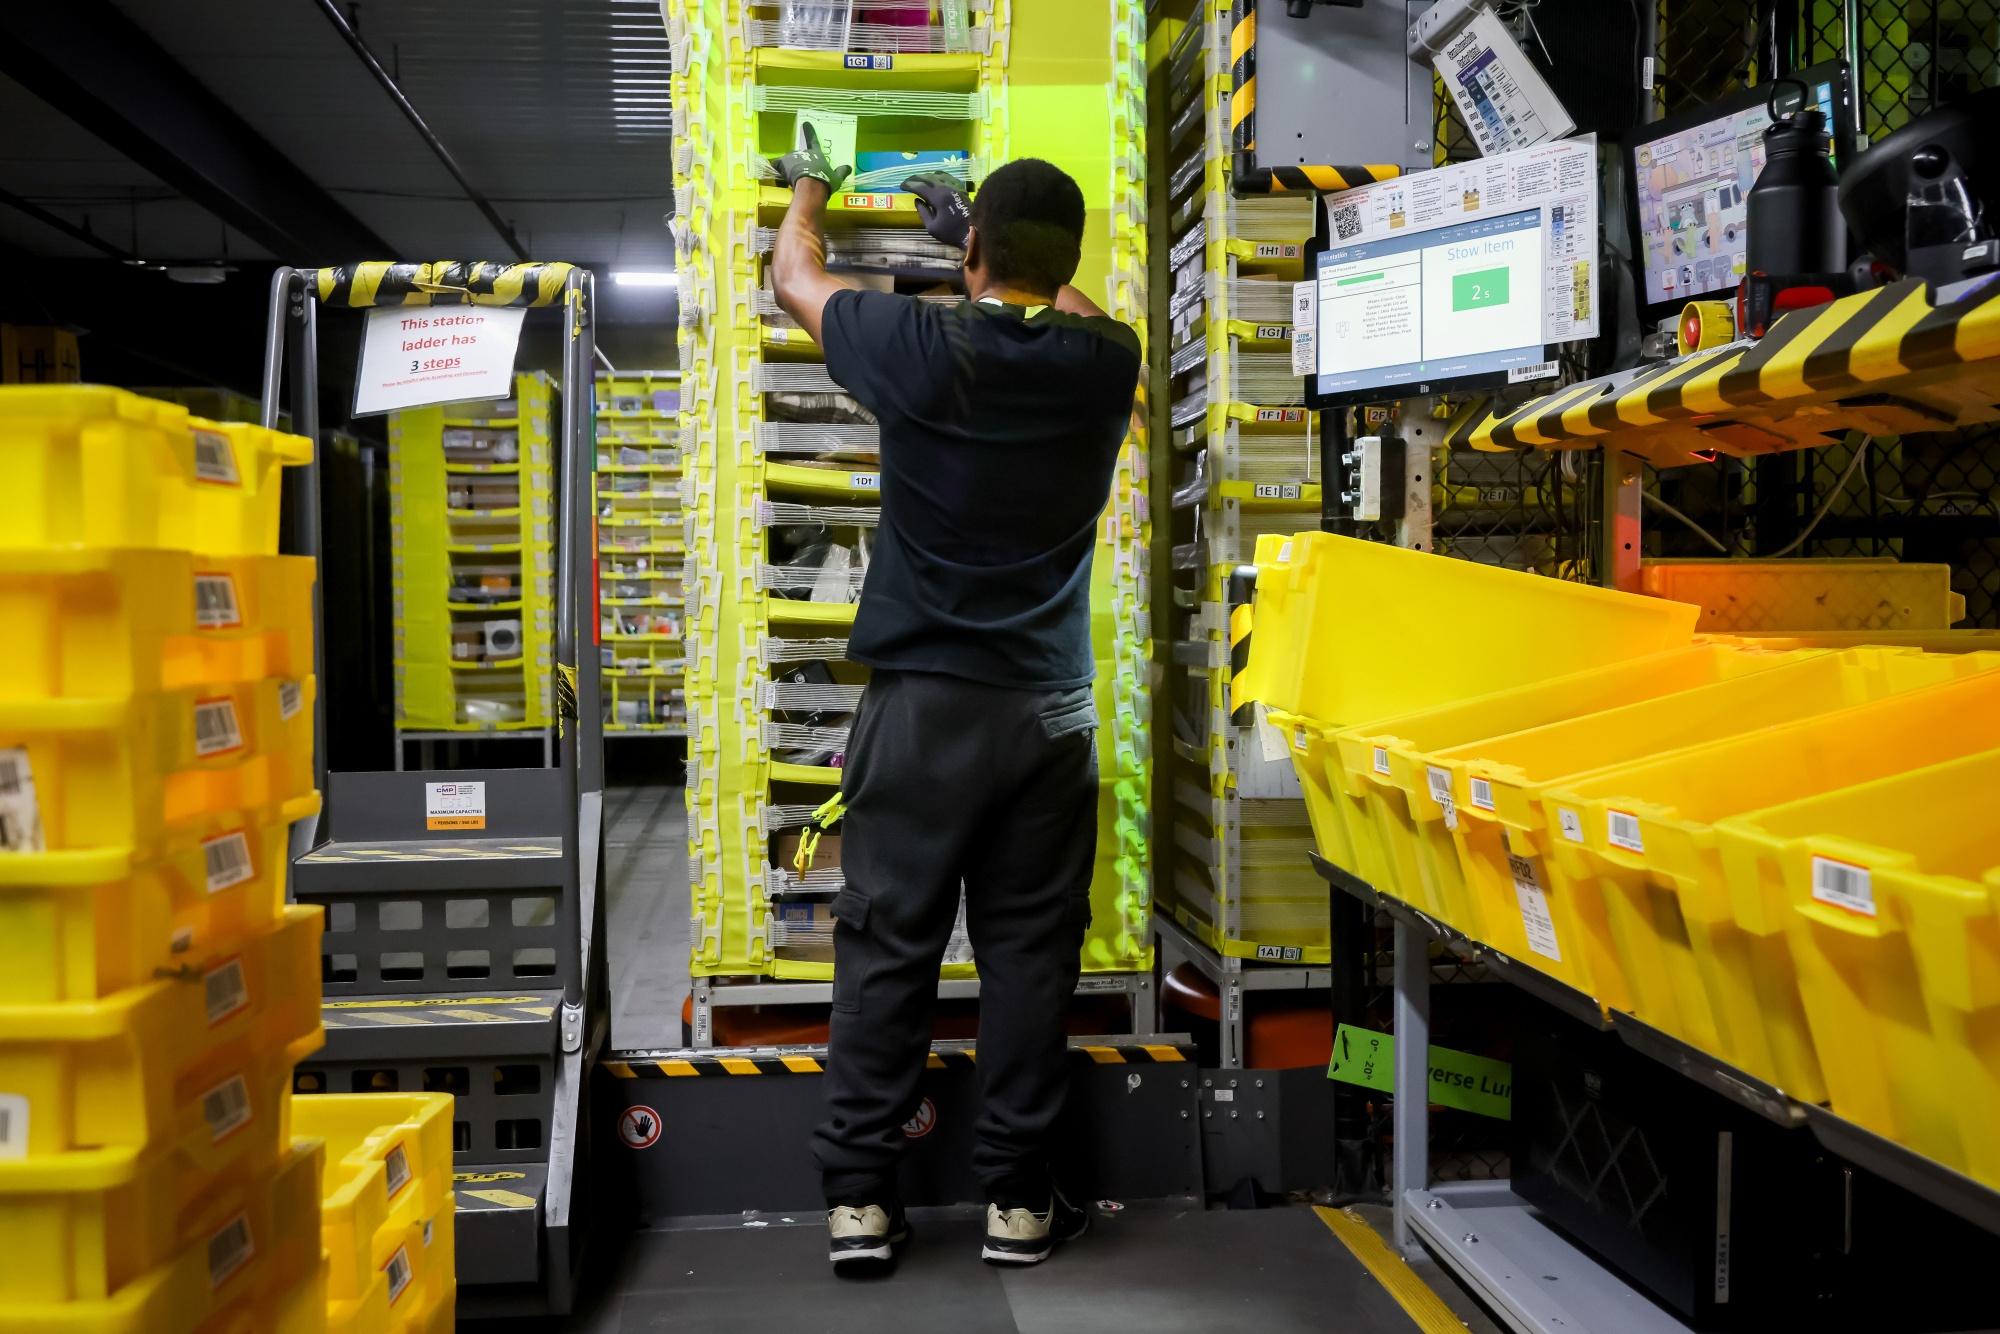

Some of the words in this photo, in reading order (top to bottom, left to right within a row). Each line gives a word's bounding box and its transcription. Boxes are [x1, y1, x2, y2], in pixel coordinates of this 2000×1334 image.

[849, 58, 862, 66] 1G
[1746, 116, 1763, 126] Kitchen
[1710, 128, 1725, 139] Journal
[1260, 246, 1274, 255] 1H
[1447, 246, 1479, 261] Stow
[1484, 239, 1514, 254] Item
[1472, 284, 1481, 300] 2
[1484, 290, 1490, 298] s
[401, 317, 429, 331] This
[432, 315, 484, 327] station
[1261, 328, 1275, 337] 1G
[402, 337, 447, 352] ladder
[451, 334, 477, 346] has
[411, 360, 419, 371] 3
[423, 356, 461, 370] steps
[1261, 411, 1273, 419] 1F
[1371, 411, 1386, 420] 2F
[856, 477, 868, 485] 1D
[1258, 486, 1272, 495] 1E
[1261, 947, 1274, 957] 1A
[1370, 1039, 1379, 1052] 0"
[1363, 1061, 1374, 1081] 20"
